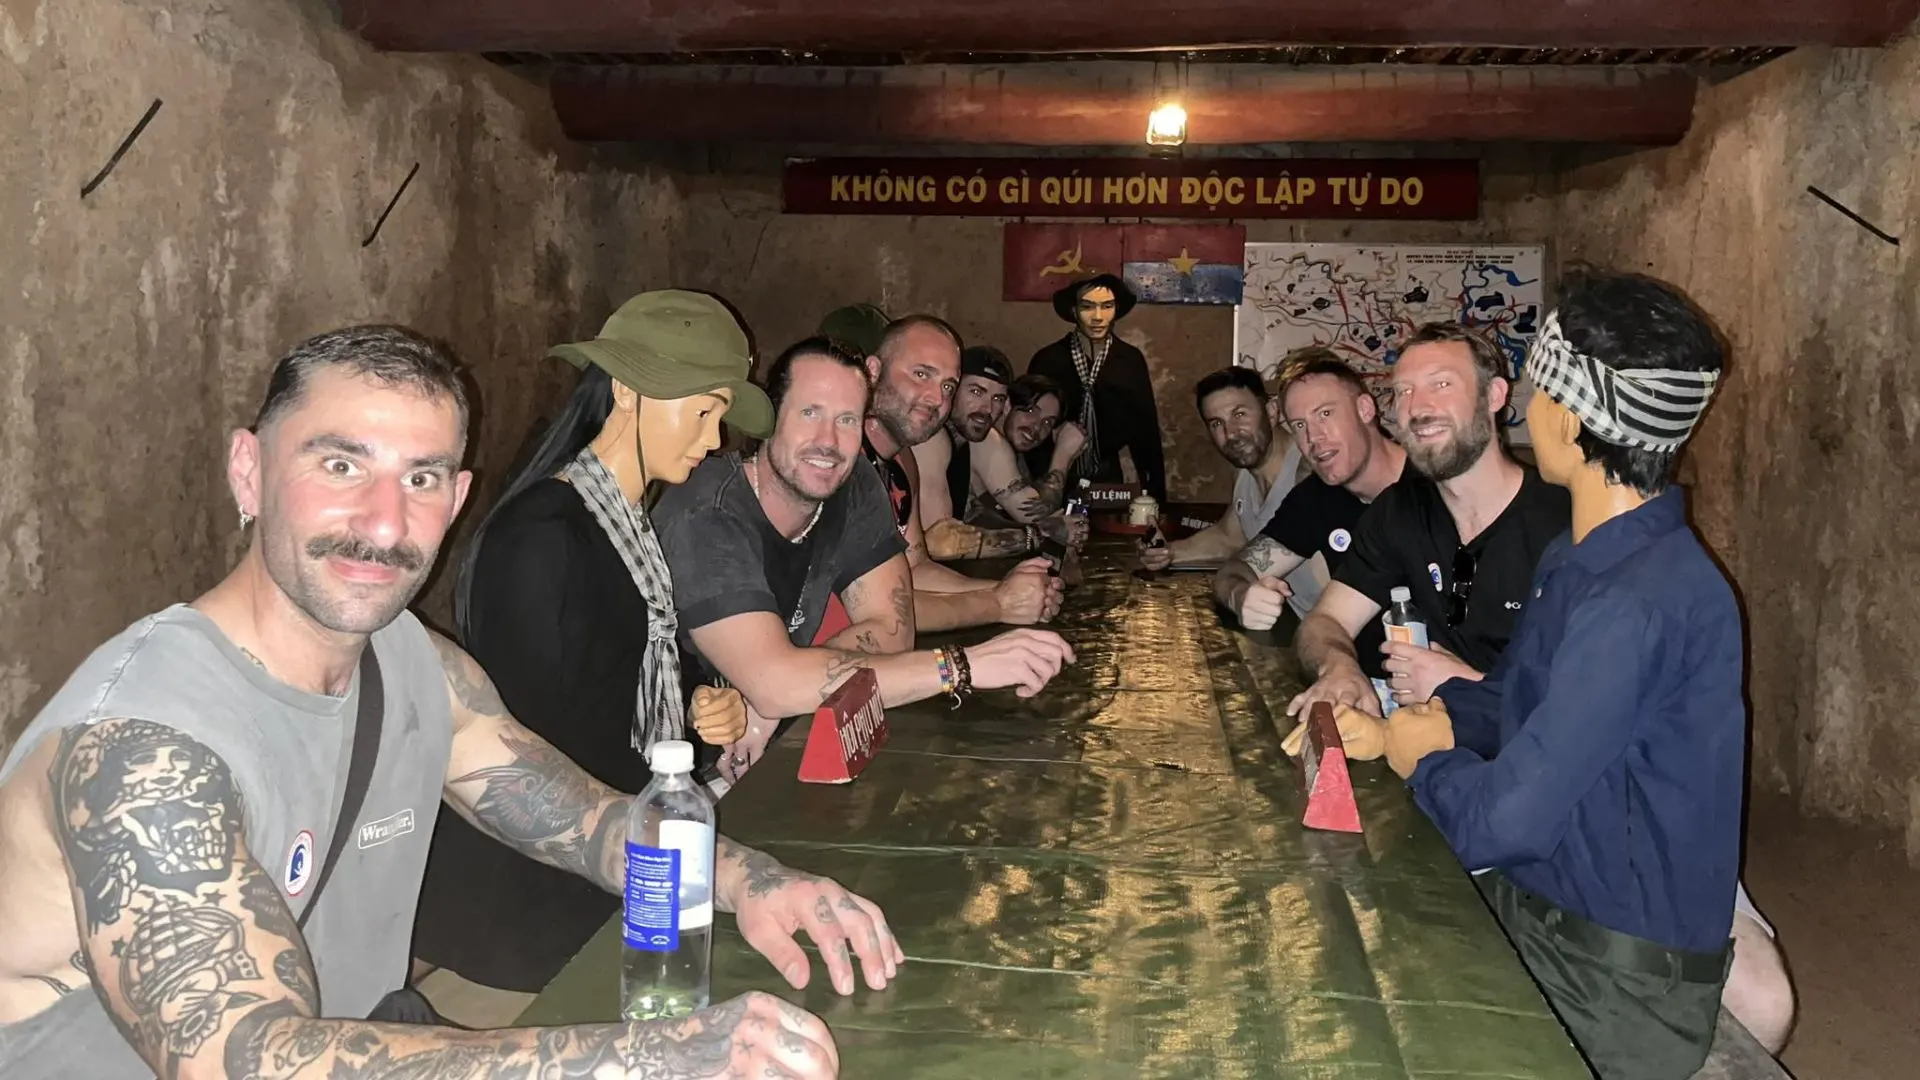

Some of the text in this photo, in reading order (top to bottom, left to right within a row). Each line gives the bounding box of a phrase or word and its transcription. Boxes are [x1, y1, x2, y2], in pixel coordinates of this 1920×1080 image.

[831, 168, 1424, 212] KHÔNG CÓ GÌ QÚI HƠN ĐỘC LẬP TỰ DO
[1102, 489, 1131, 502] LỆNH
